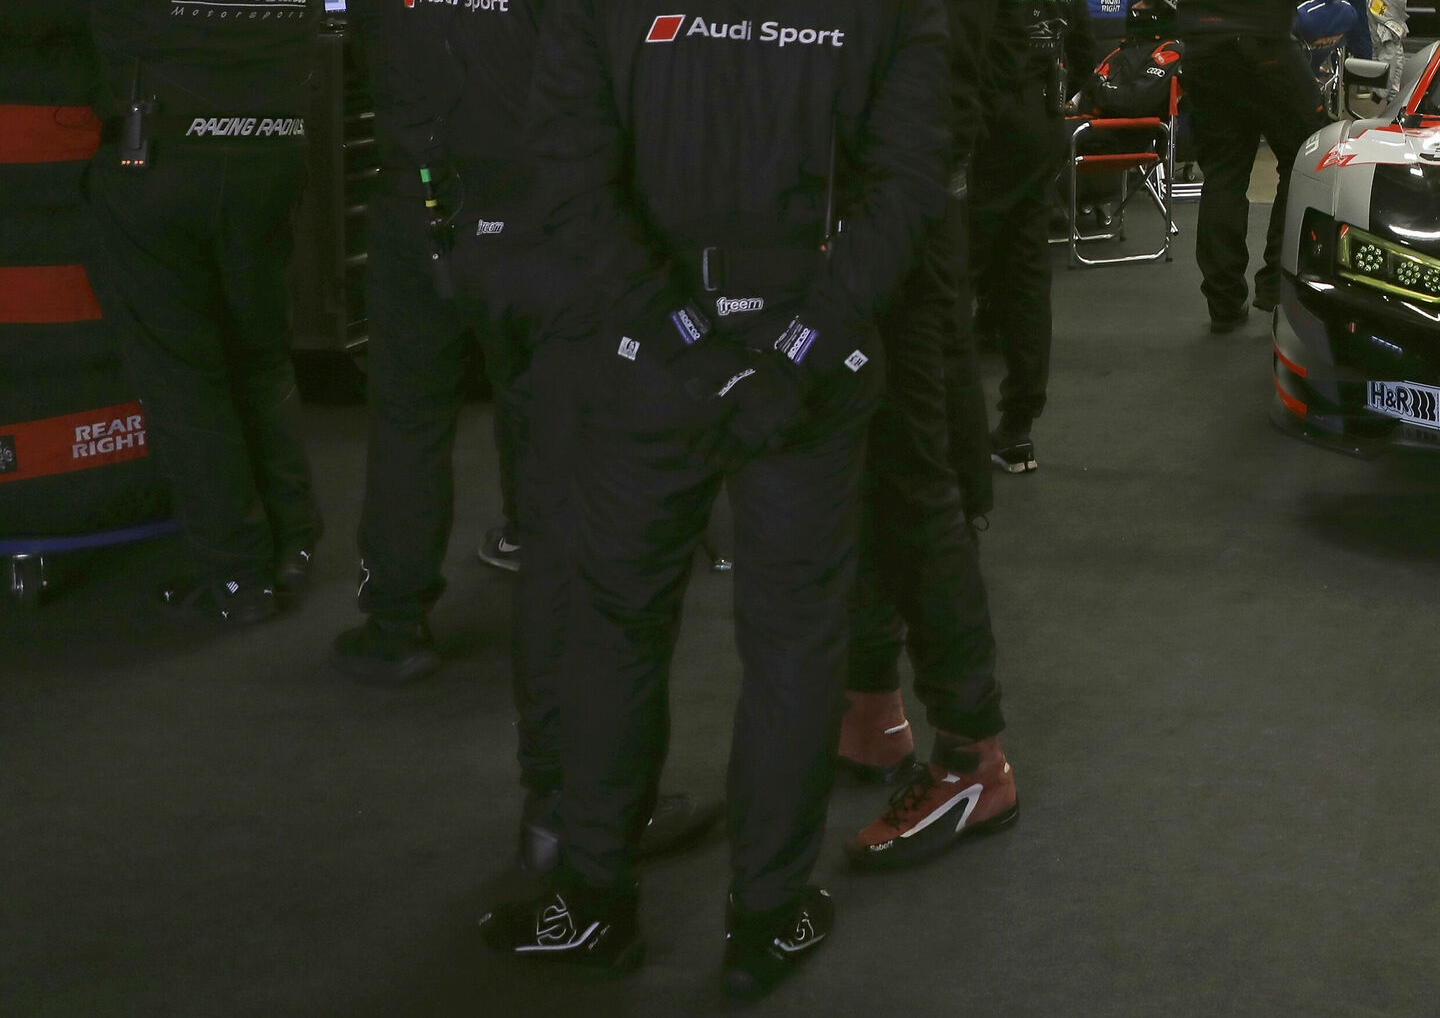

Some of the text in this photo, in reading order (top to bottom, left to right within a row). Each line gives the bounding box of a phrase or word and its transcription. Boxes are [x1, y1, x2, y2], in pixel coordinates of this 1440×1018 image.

[171, 6, 304, 20] Motorsport
[1101, 5, 1121, 13] RIGHT
[687, 17, 845, 47] Audi Sport
[185, 118, 258, 137] RACING
[716, 297, 764, 316] freem
[1371, 383, 1411, 413] H&R
[75, 414, 142, 443] REAR
[71, 430, 146, 459] RIGHT
